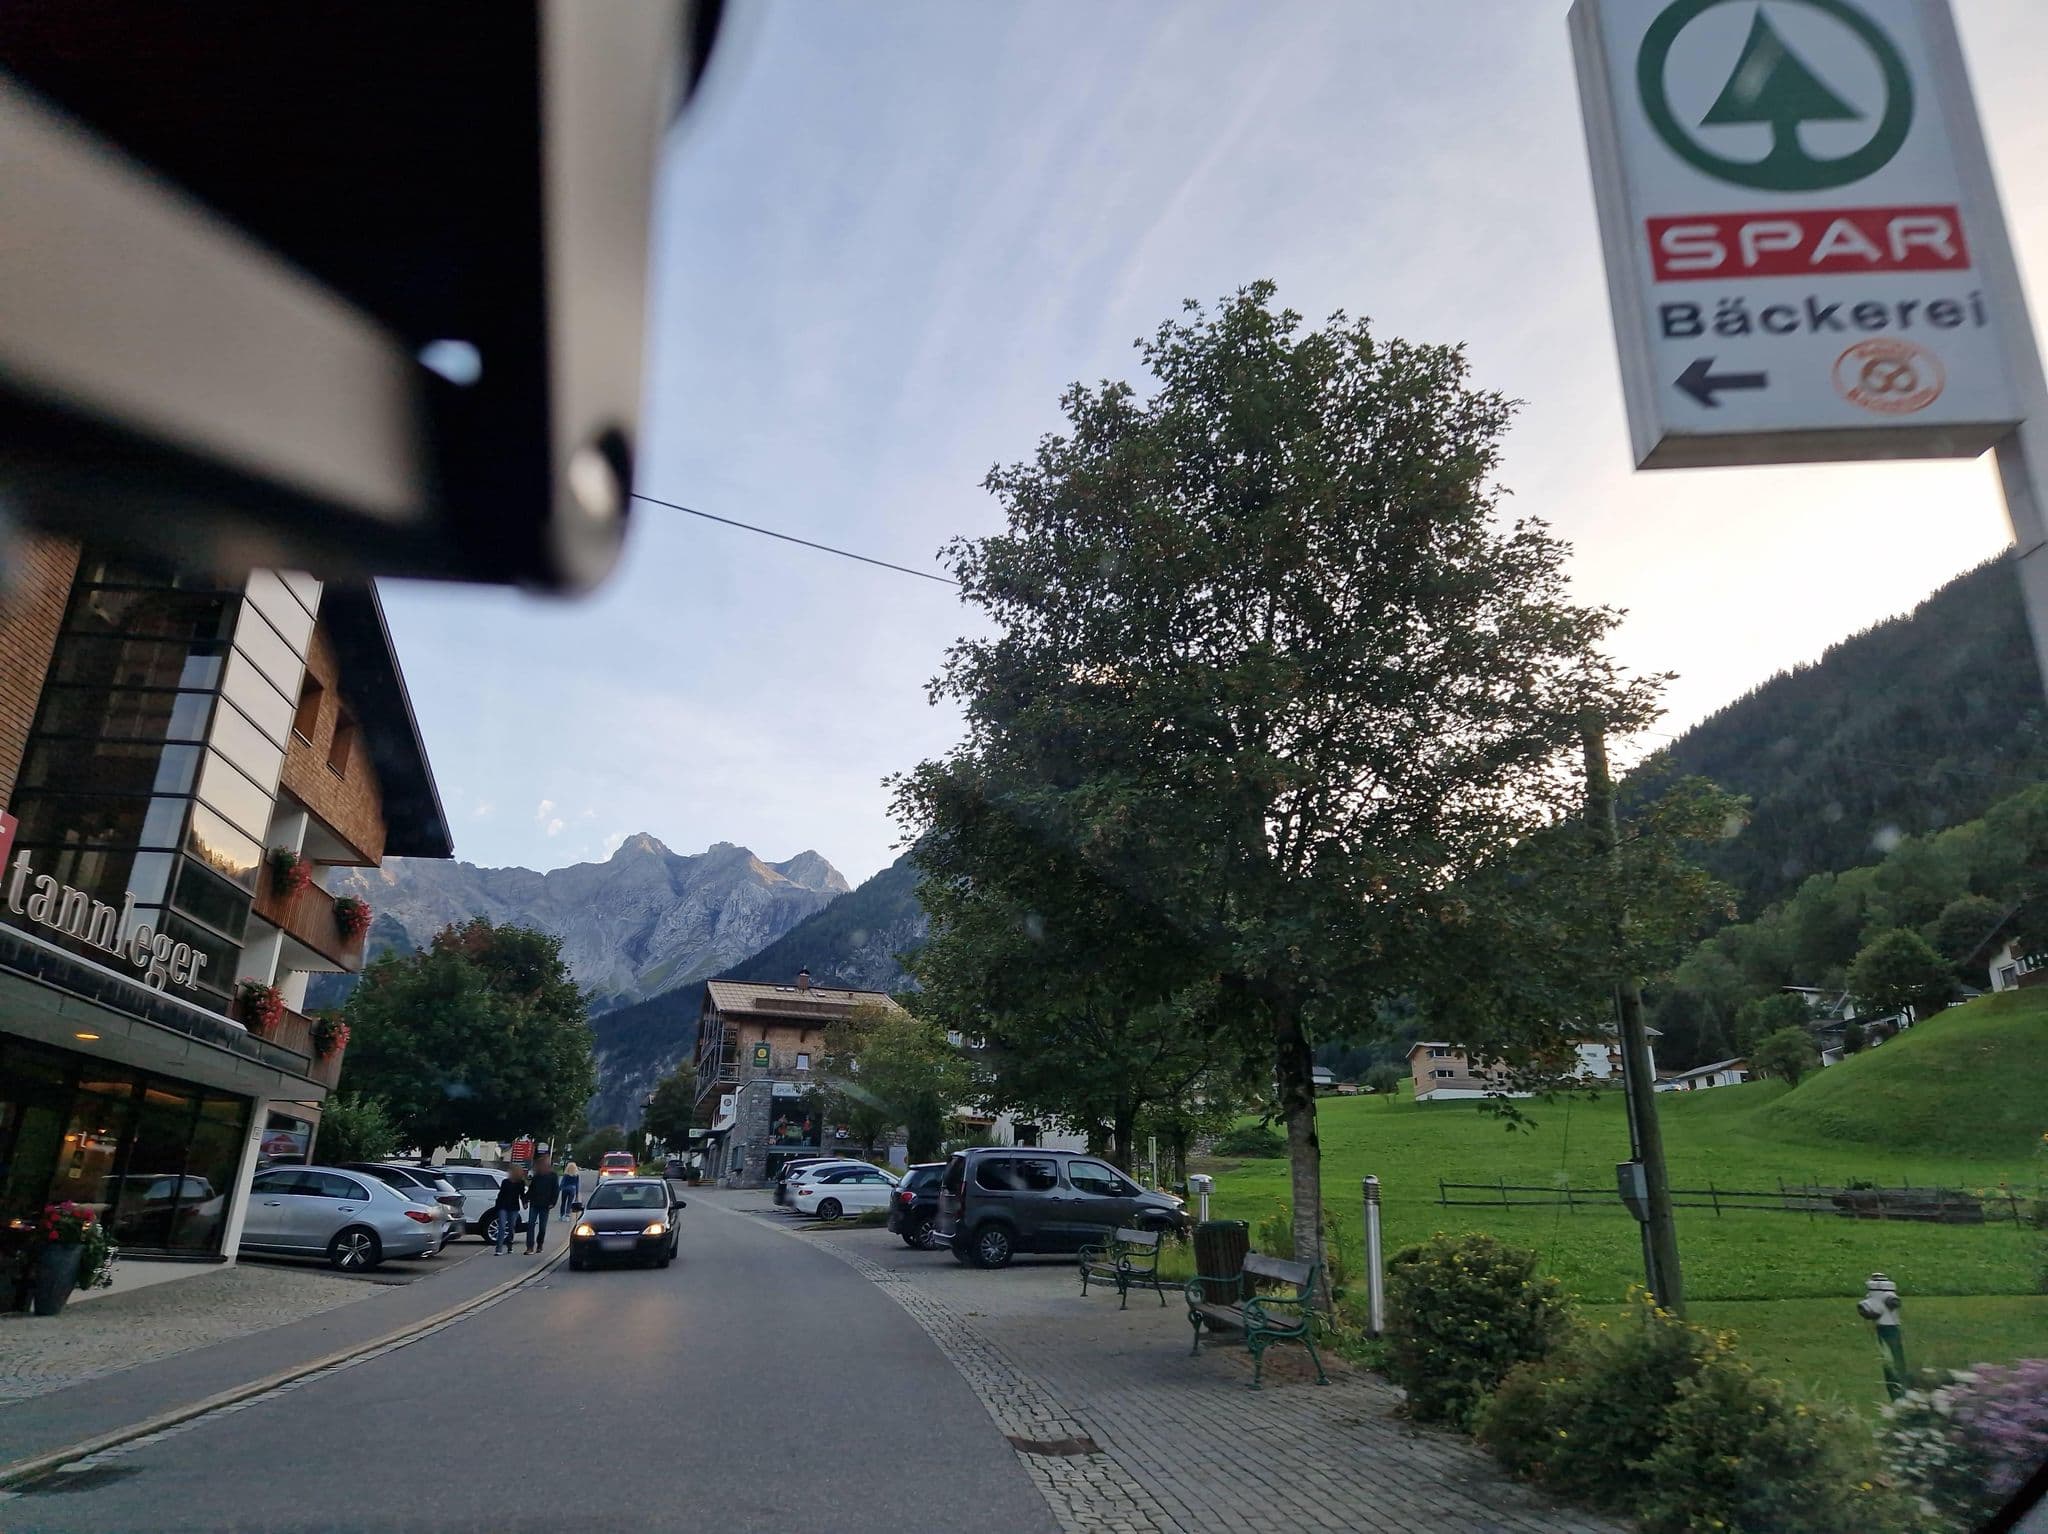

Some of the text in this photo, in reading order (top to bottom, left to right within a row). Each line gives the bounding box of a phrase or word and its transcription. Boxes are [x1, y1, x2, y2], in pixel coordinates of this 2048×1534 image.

[1660, 217, 1957, 271] SPAR
[1660, 291, 1988, 338] Bäckerei
[8, 849, 208, 992] tannleger
